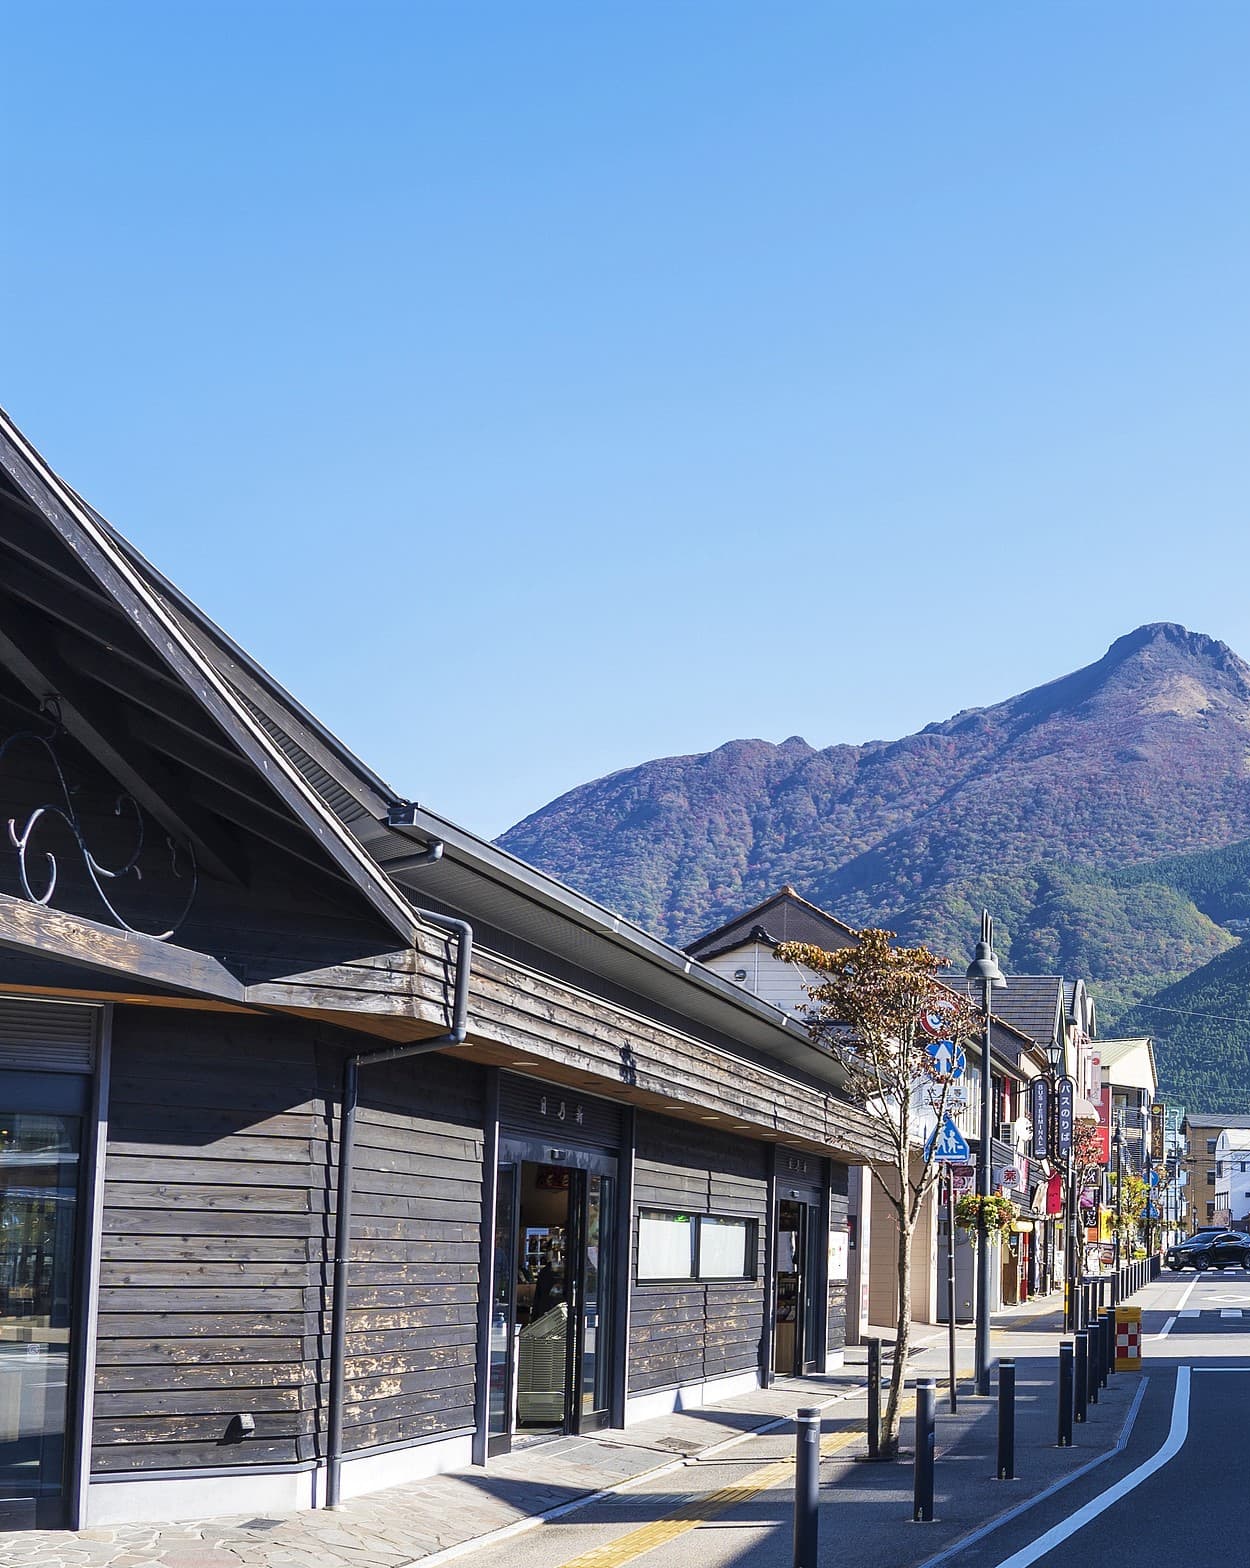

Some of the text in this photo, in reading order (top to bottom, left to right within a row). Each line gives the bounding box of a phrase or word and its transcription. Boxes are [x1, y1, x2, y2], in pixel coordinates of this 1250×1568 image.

[1060, 1085, 1071, 1142] バスのりば
